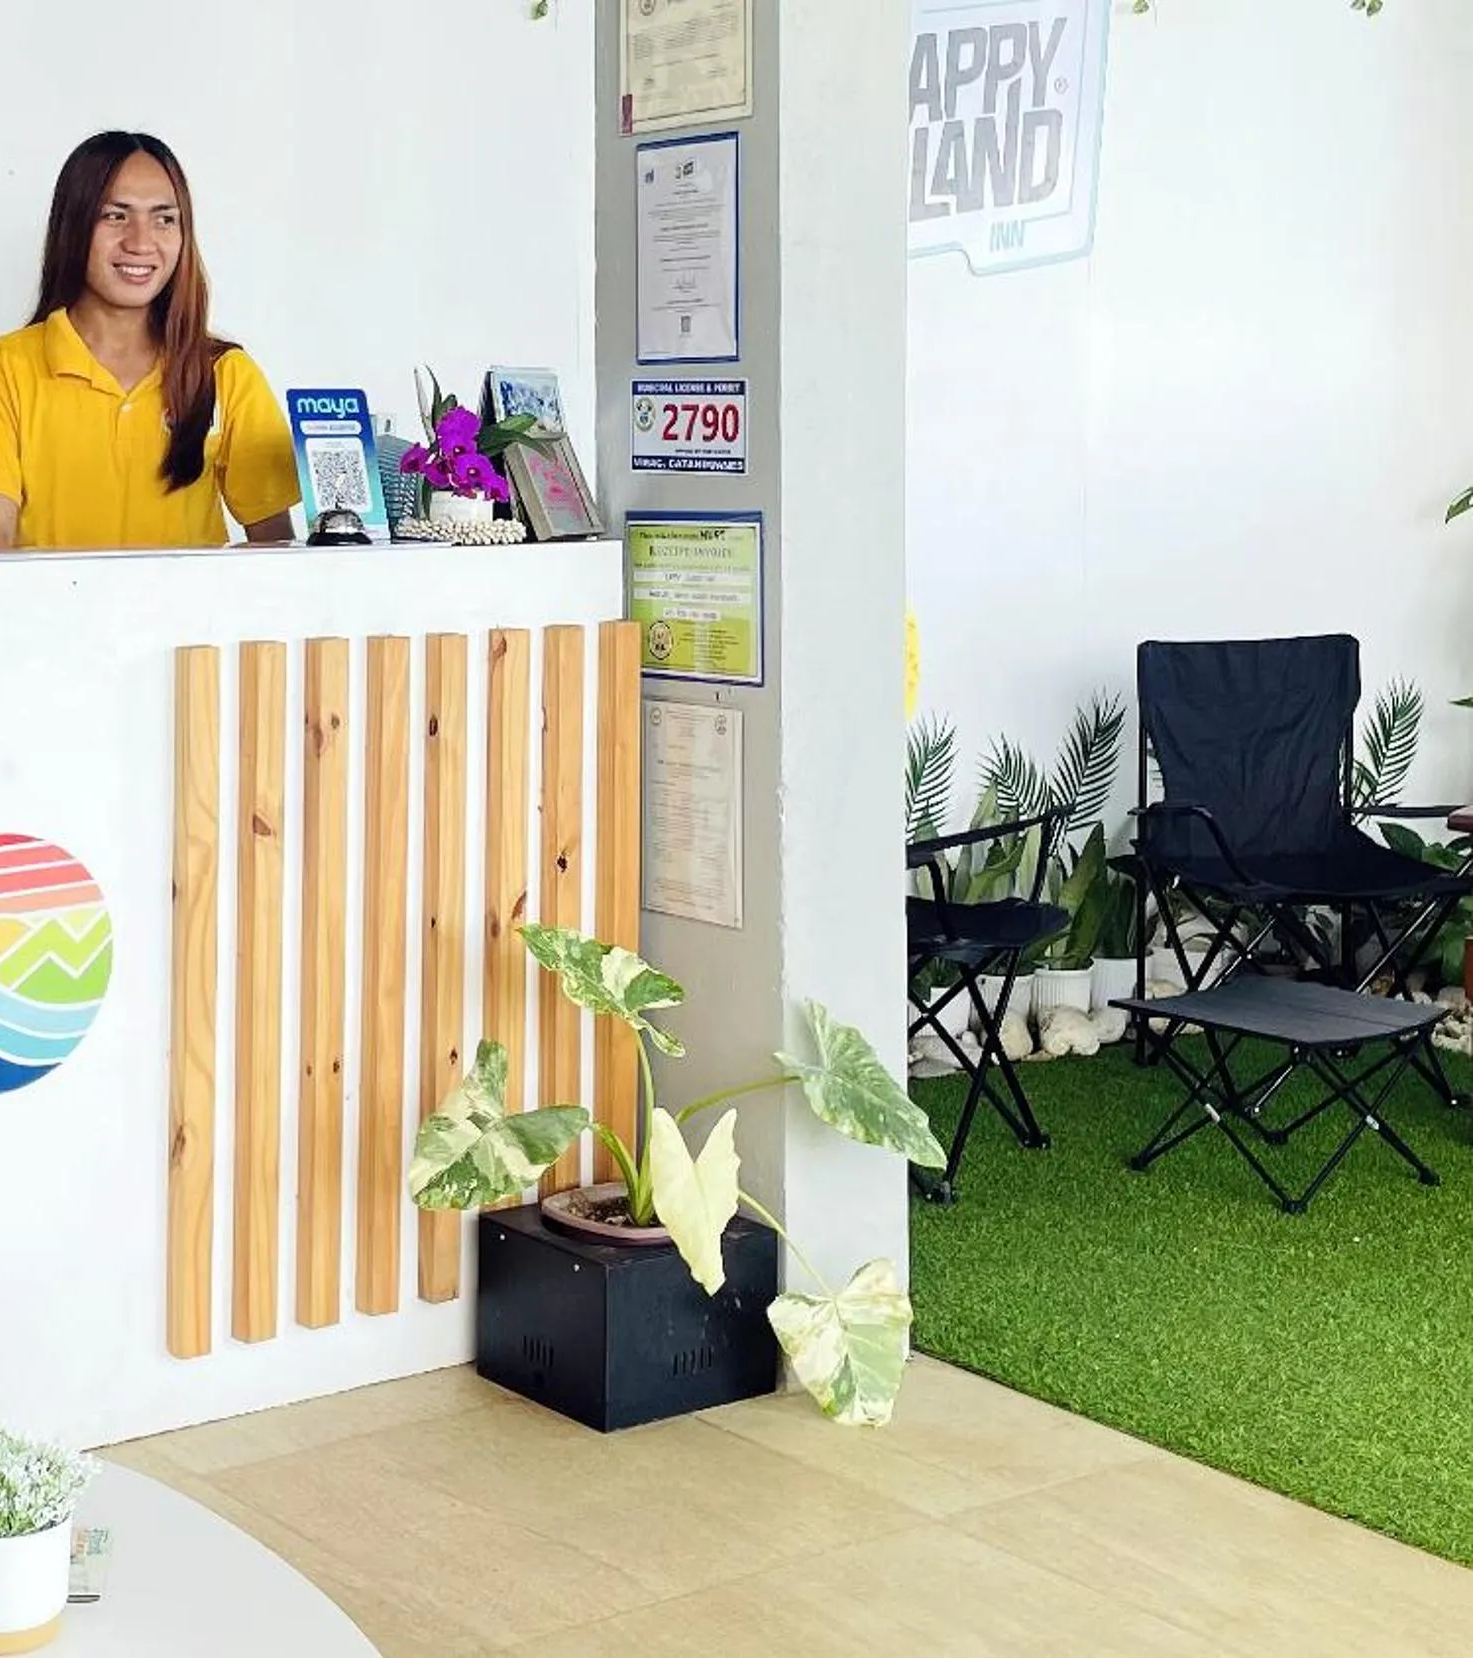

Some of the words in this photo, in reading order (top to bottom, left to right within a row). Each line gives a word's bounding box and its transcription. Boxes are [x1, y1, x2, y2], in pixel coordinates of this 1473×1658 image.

[909, 17, 1067, 125] APPY
[909, 78, 1063, 222] LAND
[989, 219, 1026, 252] INN
[297, 397, 360, 419] maya
[662, 403, 740, 442] 2790
